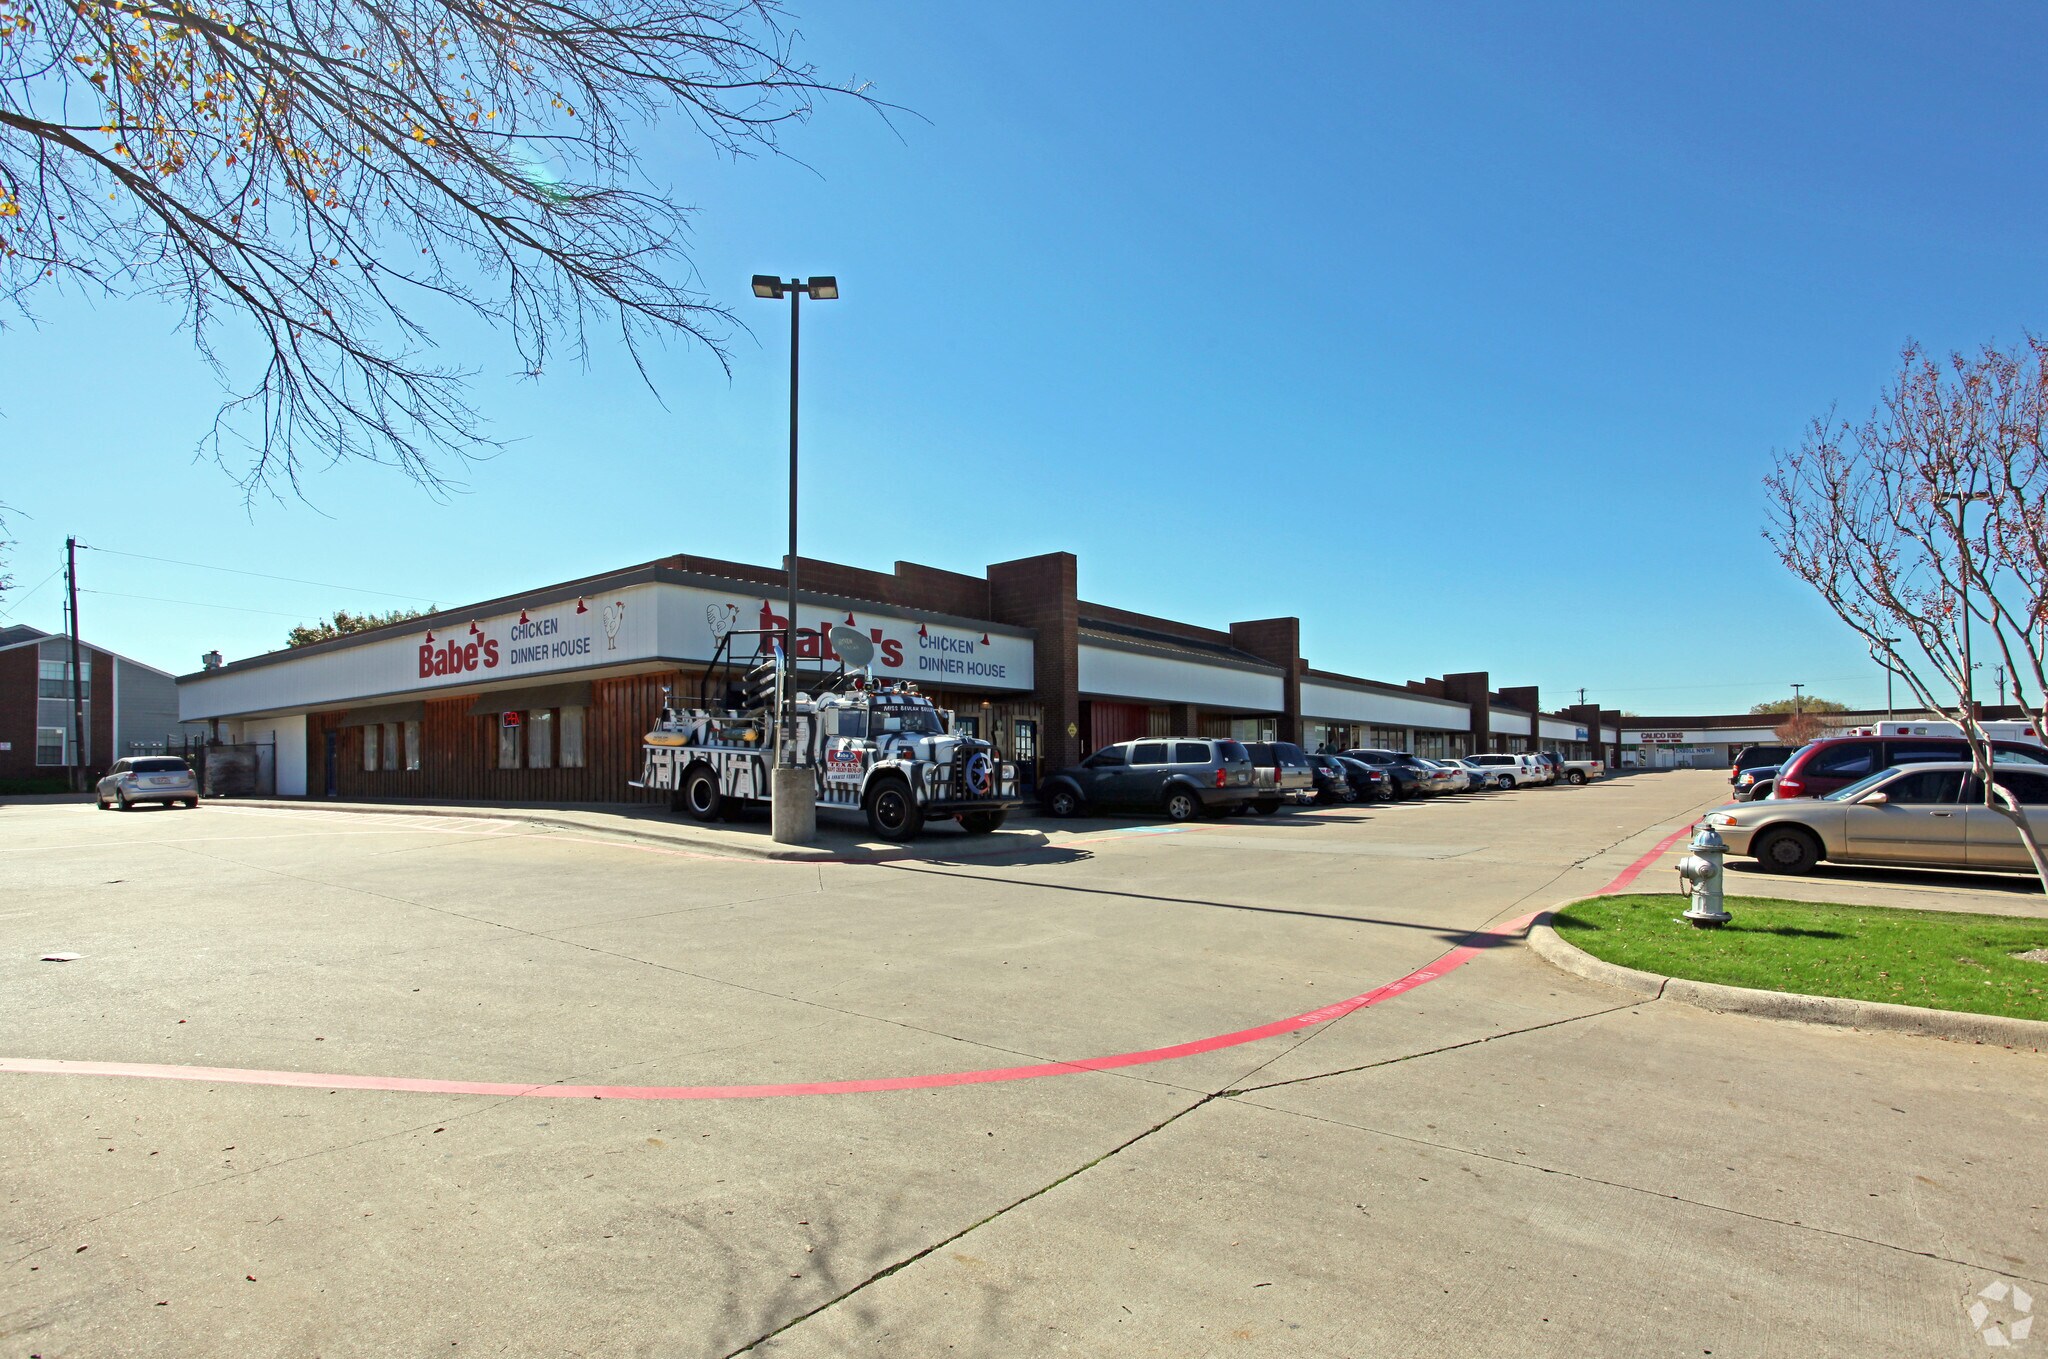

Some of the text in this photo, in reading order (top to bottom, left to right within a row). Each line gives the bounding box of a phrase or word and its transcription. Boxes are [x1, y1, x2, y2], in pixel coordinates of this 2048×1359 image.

[511, 617, 558, 641] CHICKEN
[760, 613, 903, 667] Bab's
[419, 632, 499, 678] Babe's
[511, 637, 591, 664] DINNER HOUSE
[919, 635, 974, 654] CHICKEN
[919, 656, 1006, 678] DINNER HOUSE
